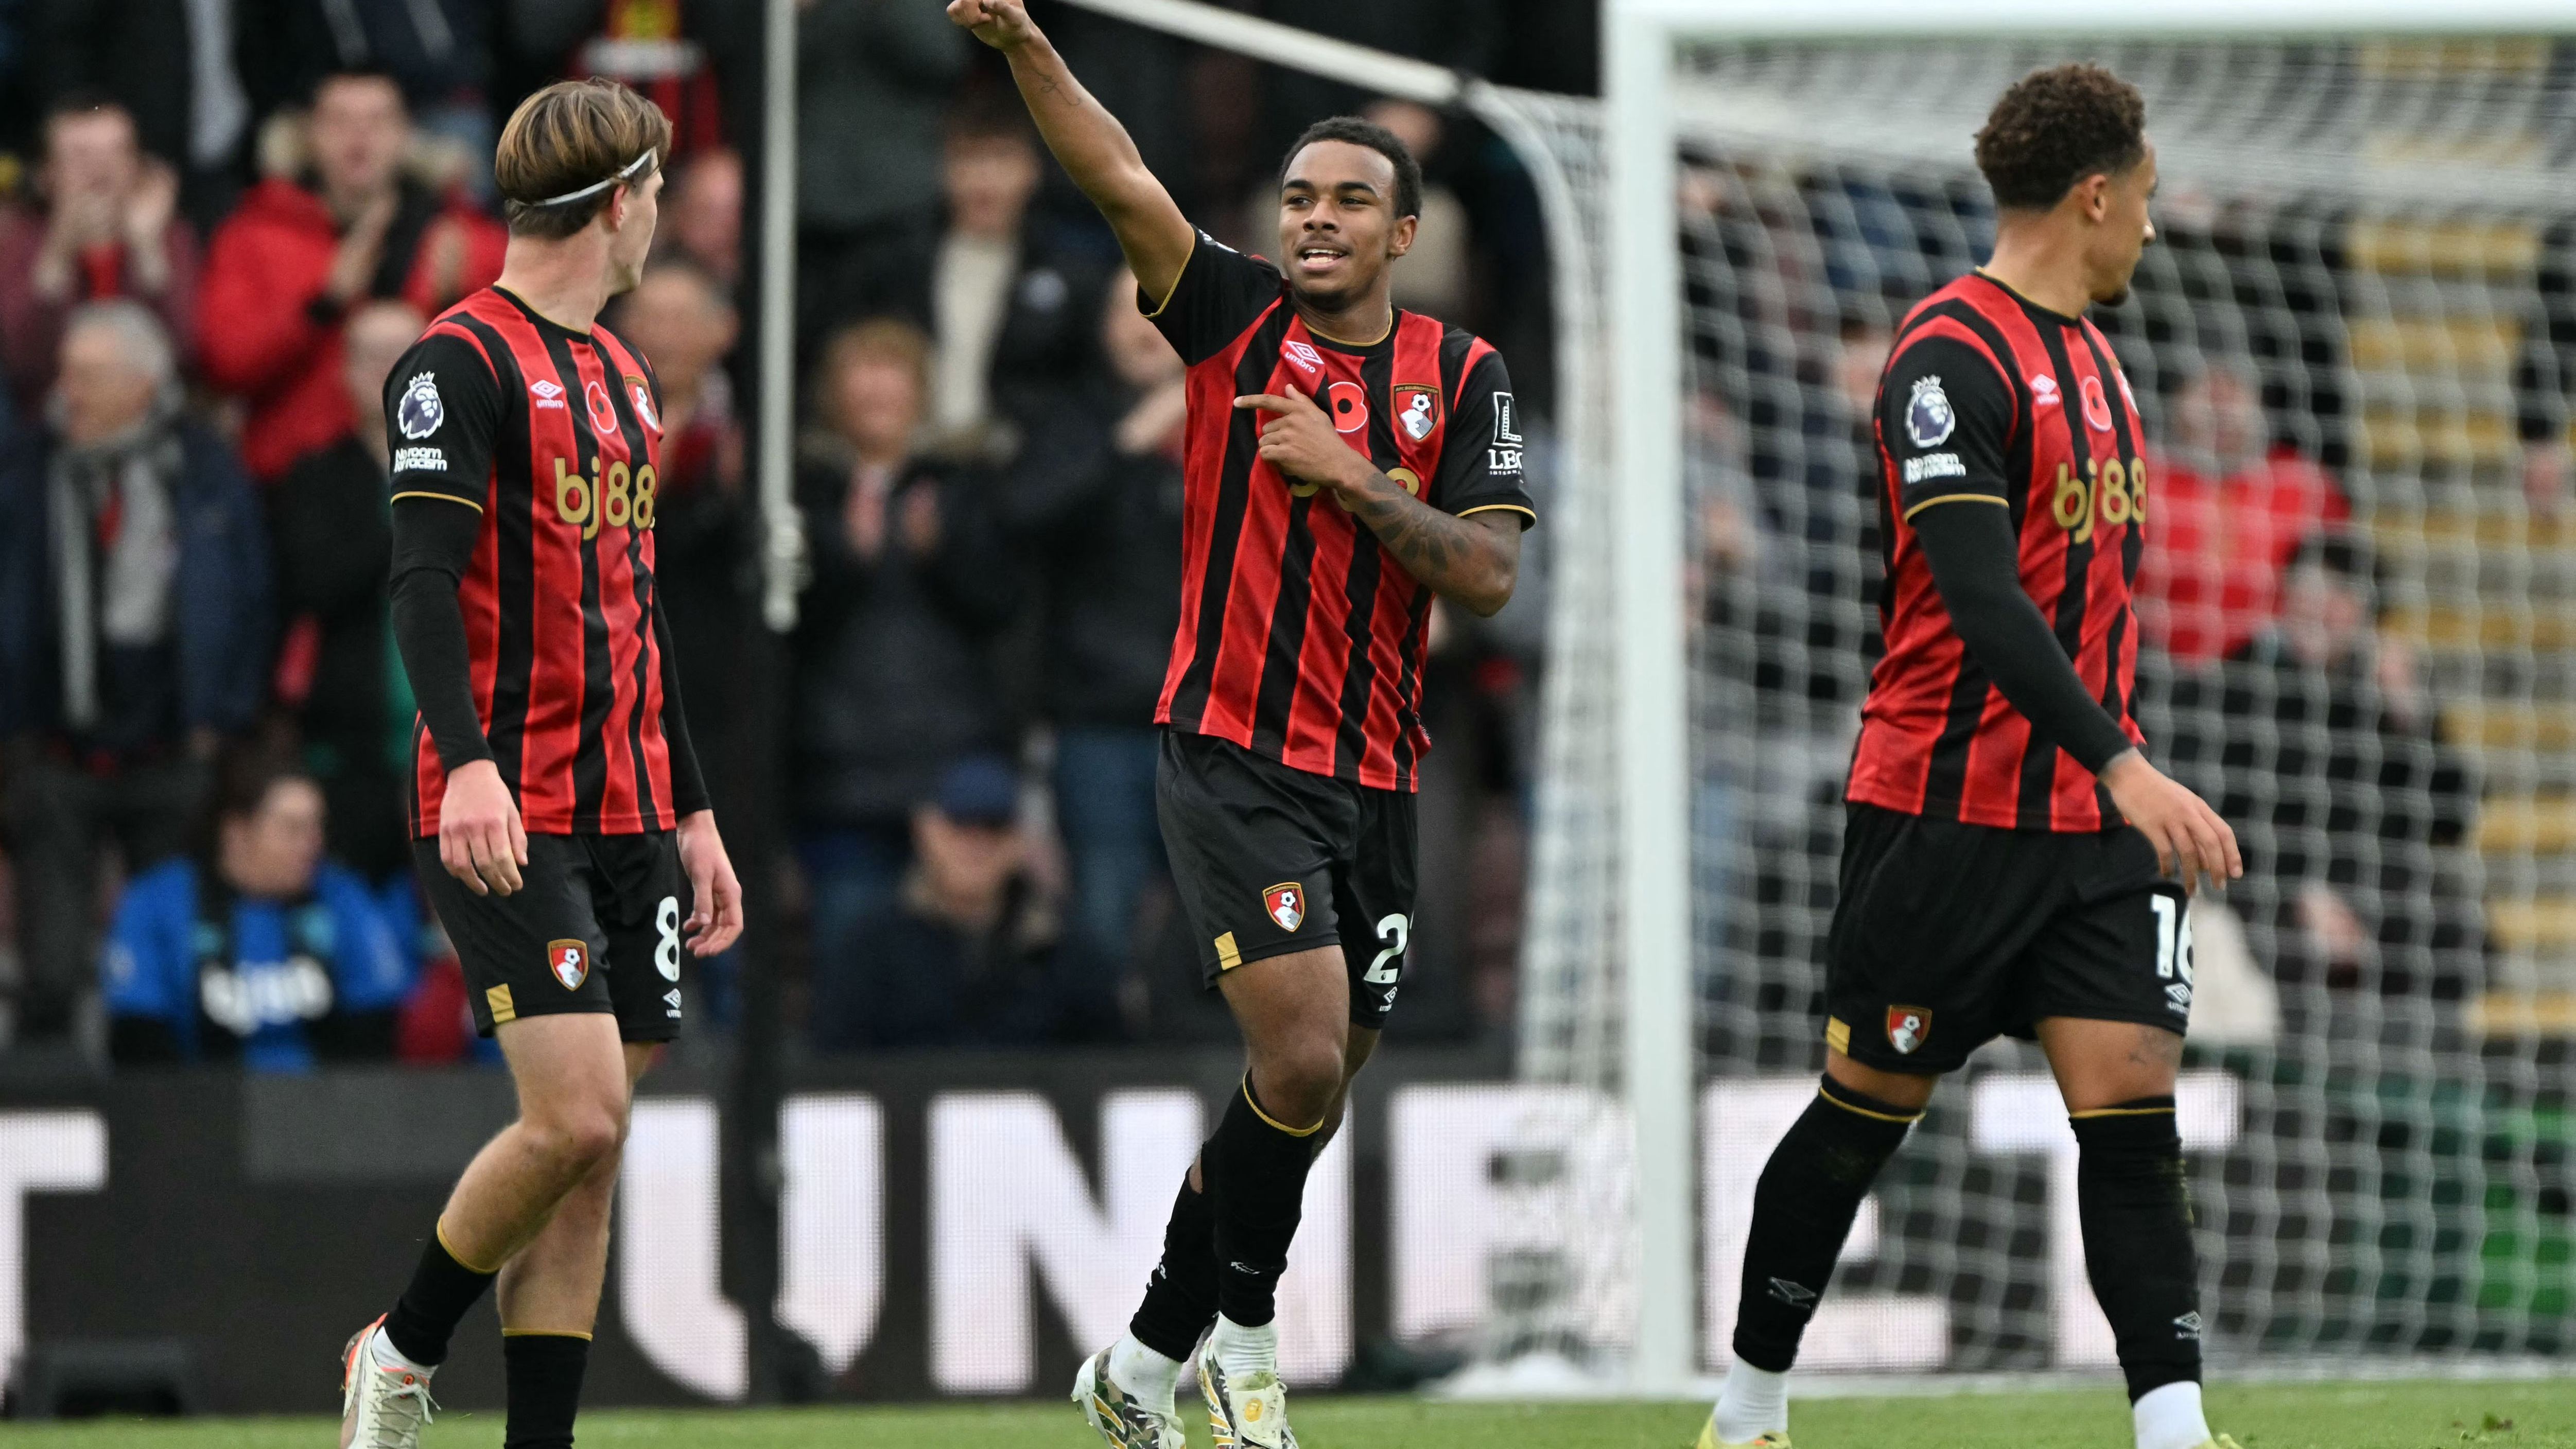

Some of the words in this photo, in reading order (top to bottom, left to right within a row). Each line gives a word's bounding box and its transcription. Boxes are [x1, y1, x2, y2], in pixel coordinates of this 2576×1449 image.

[1285, 352, 1316, 373] umbro
[536, 399, 564, 409] umbro
[407, 447, 442, 459] room
[554, 456, 656, 540] bj88
[2053, 457, 2147, 544] bj88
[655, 896, 680, 982] 8
